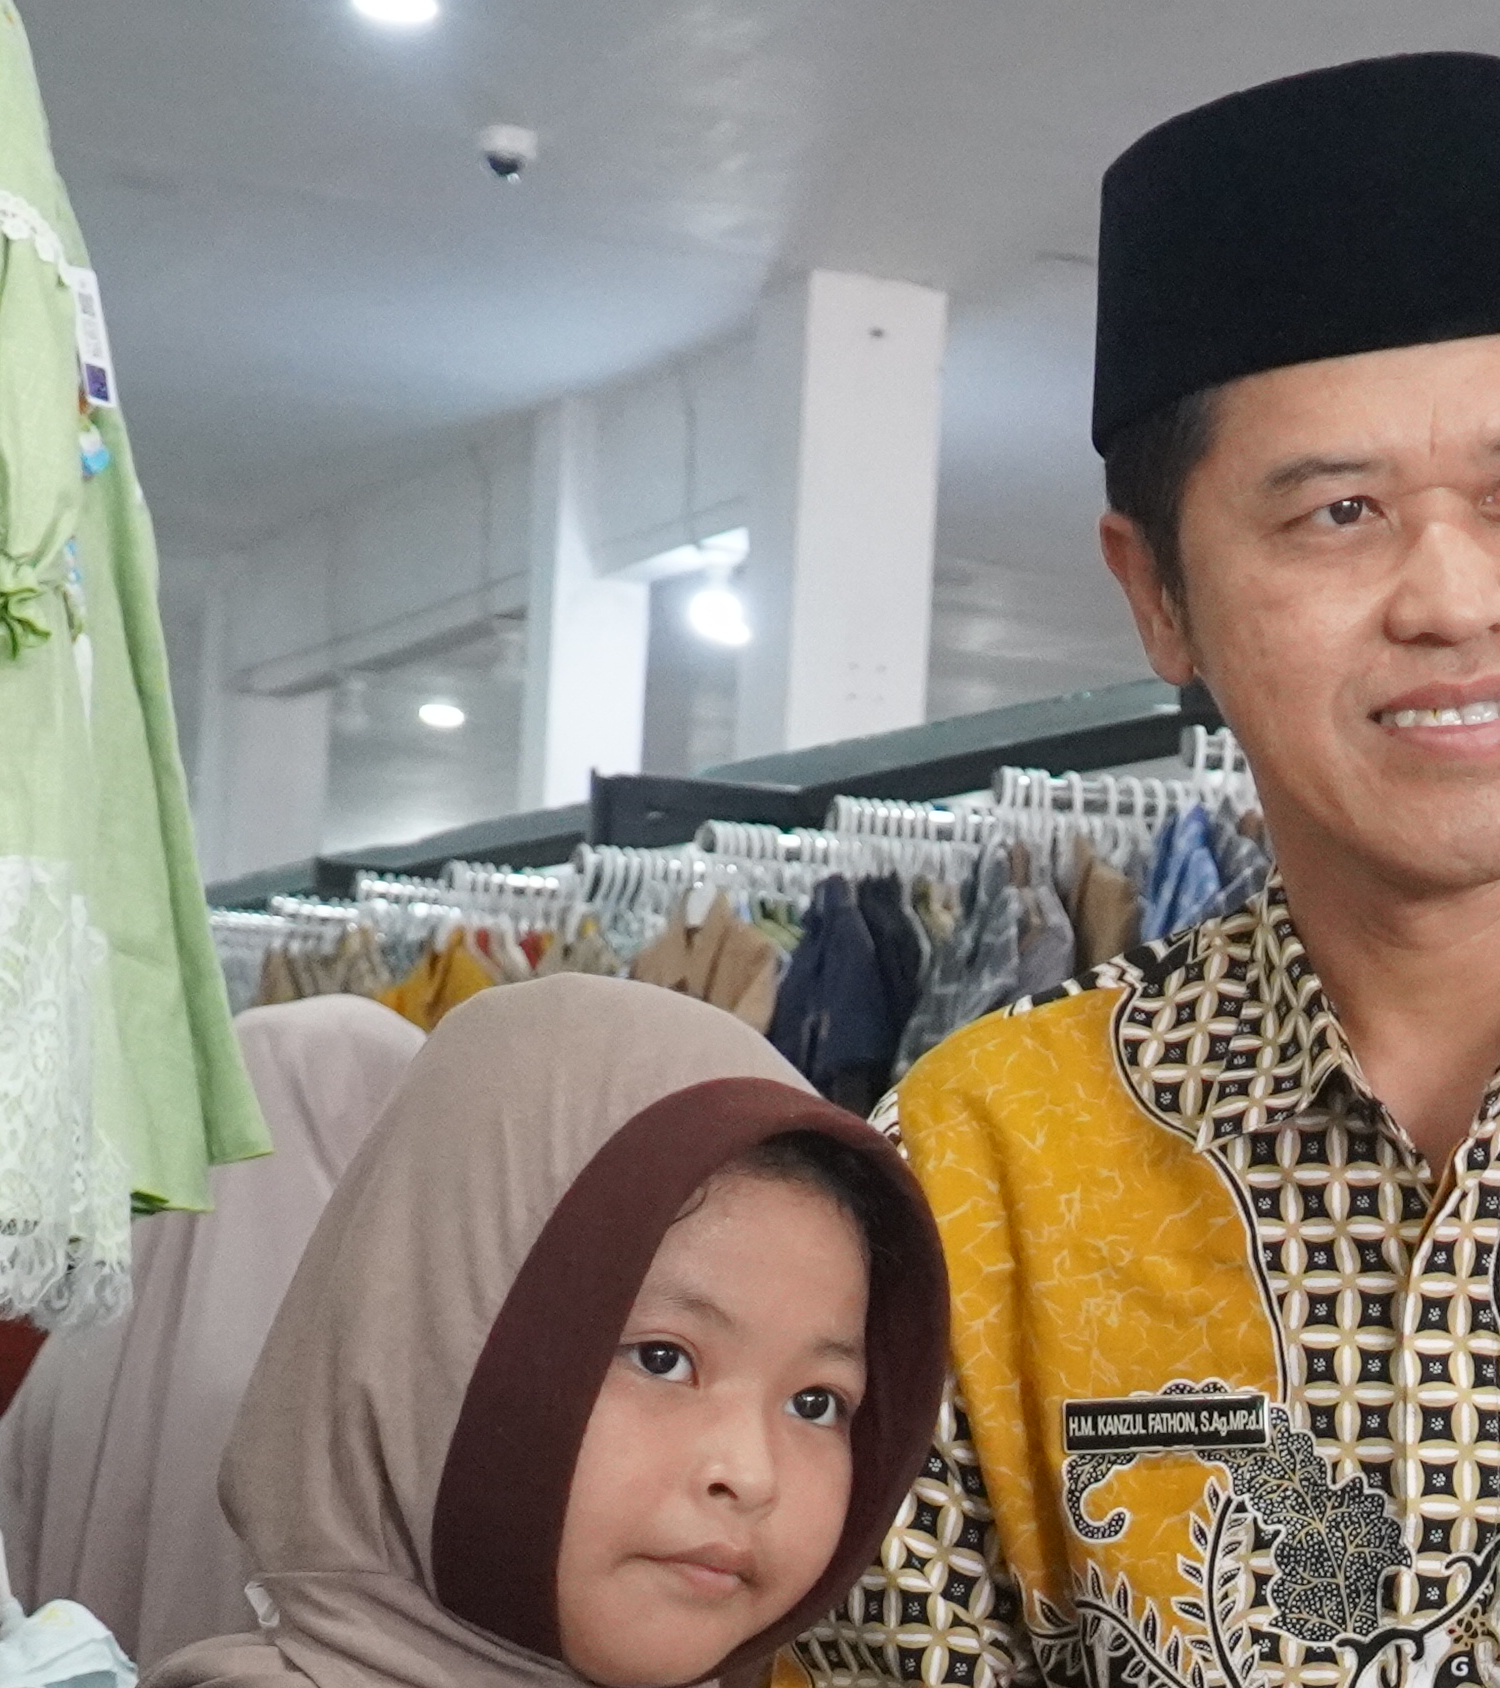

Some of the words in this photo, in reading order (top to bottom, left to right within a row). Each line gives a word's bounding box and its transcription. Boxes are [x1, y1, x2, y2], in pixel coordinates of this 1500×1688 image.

[1069, 1416, 1095, 1437] H.M.
[1097, 1413, 1146, 1436] KANZUL
[1148, 1411, 1198, 1435] FATHON,
